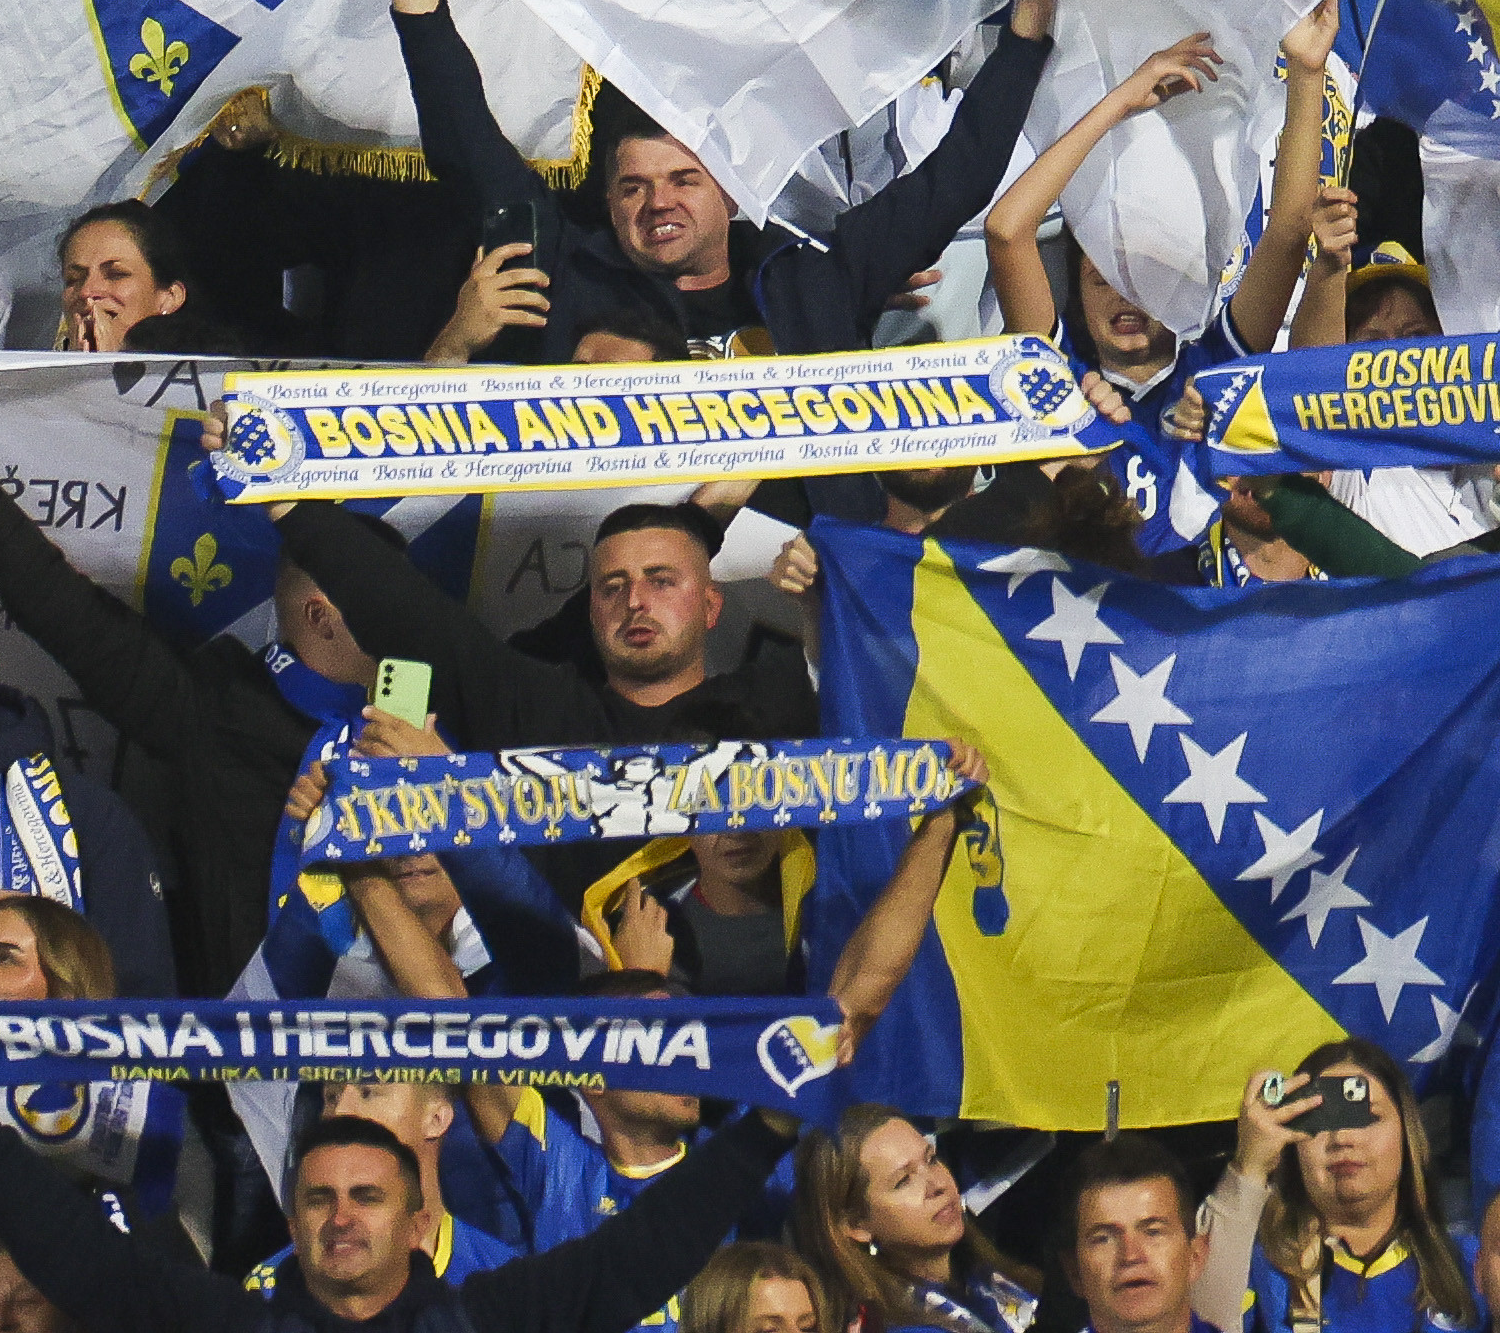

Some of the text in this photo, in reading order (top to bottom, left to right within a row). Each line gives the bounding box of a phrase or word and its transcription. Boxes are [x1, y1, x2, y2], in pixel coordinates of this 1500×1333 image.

[1347, 343, 1495, 389] BOSNA I
[305, 378, 995, 457] BOSNIA AND HERCEGOVINA
[730, 761, 858, 810] BOSNU
[237, 1012, 255, 1056] I
[269, 1012, 710, 1069] HERCEGOVINA
